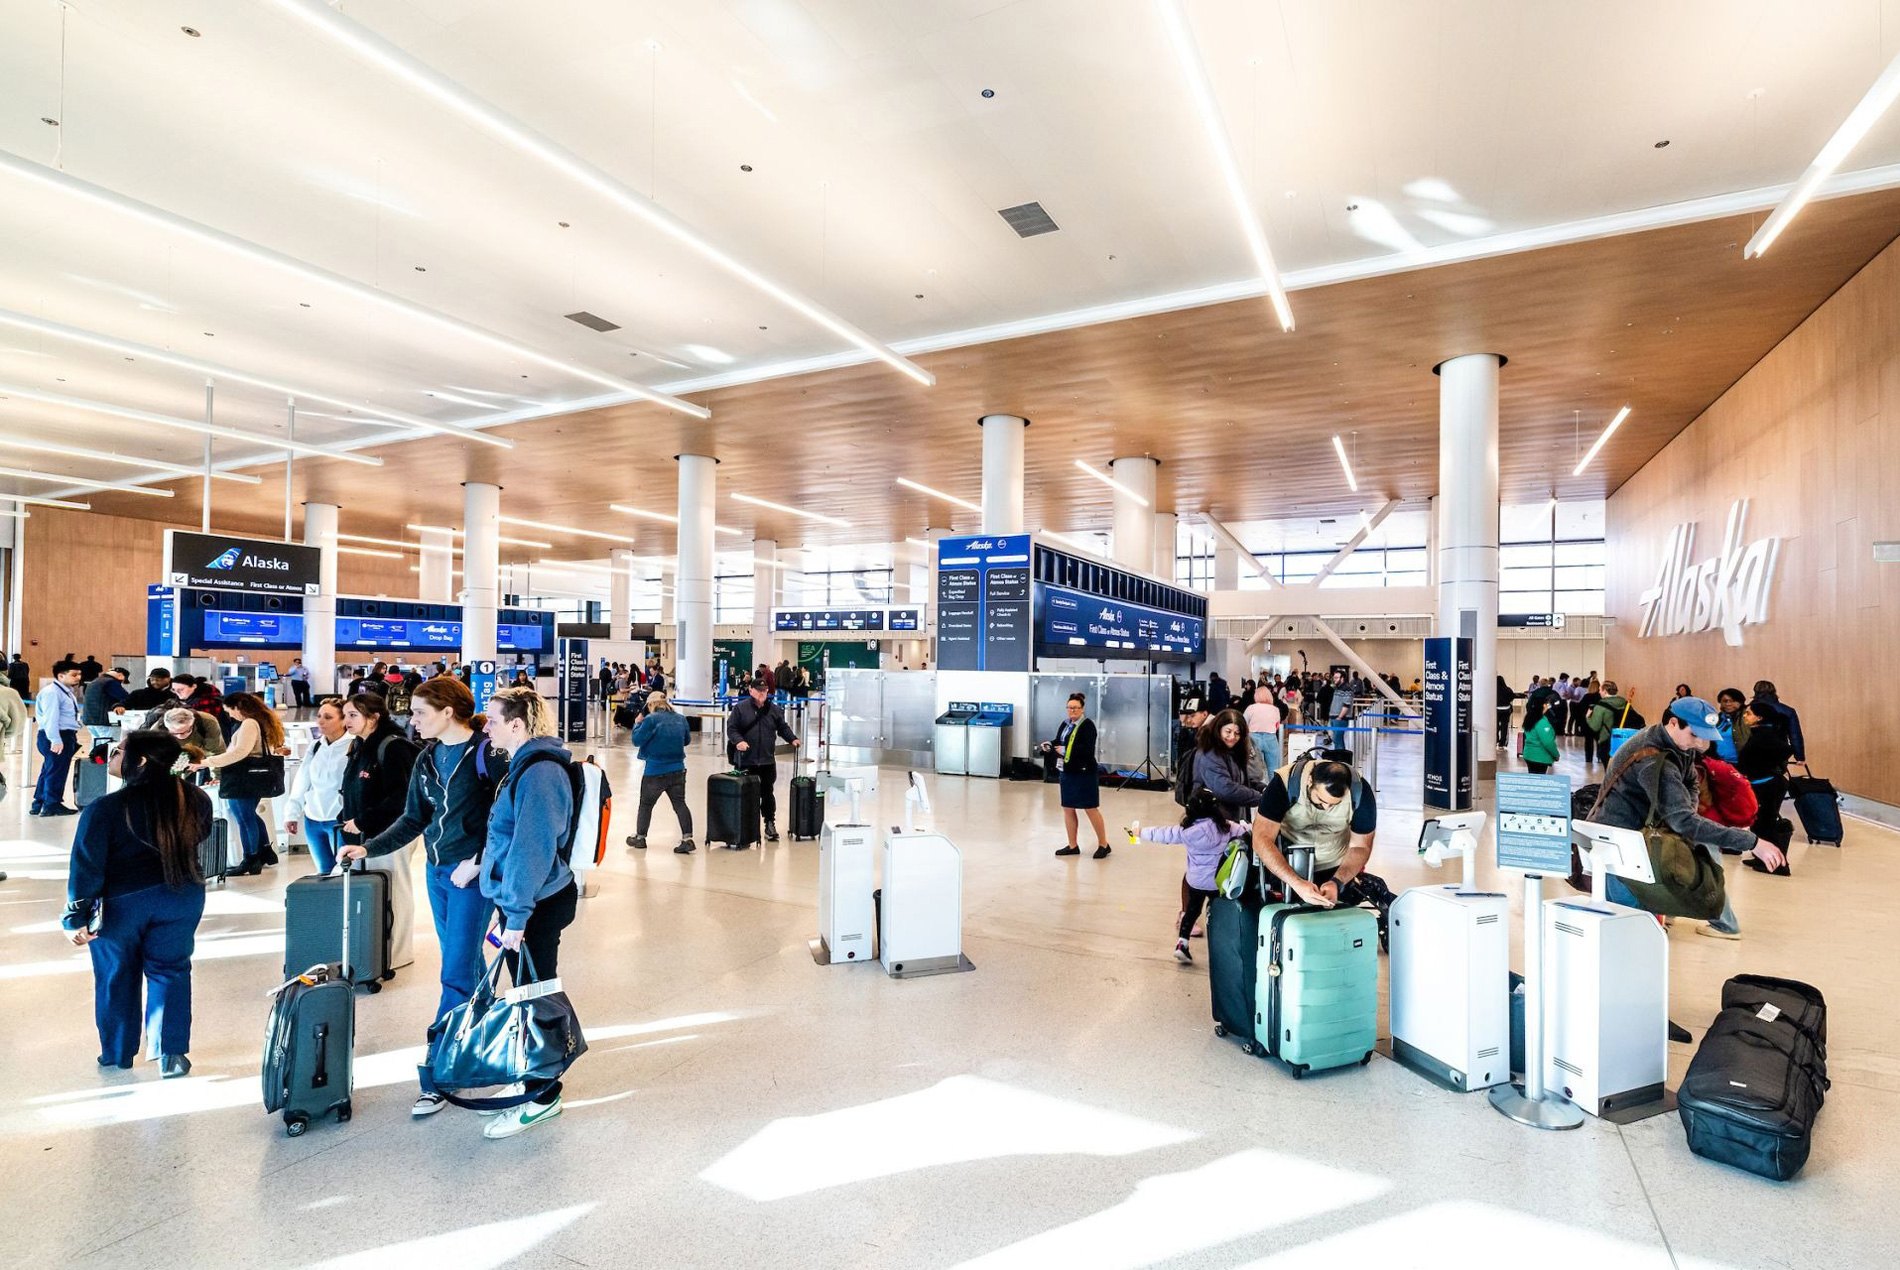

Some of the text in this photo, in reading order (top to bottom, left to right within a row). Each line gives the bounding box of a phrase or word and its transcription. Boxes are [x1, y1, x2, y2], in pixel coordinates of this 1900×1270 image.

[966, 540, 992, 550] Alaska
[242, 556, 289, 570] Alaska
[1638, 498, 1780, 646] Alaska
[191, 577, 212, 585] Special
[1099, 607, 1115, 622] Alaska
[422, 625, 448, 634] Alaska
[1089, 624, 1097, 633] First
[1098, 625, 1107, 634] Class
[1110, 627, 1120, 636] Atmos
[1121, 628, 1130, 637] Status
[484, 664, 489, 672] 1
[1426, 661, 1437, 669] First
[1458, 661, 1469, 670] First
[1426, 671, 1448, 680] Class &
[481, 682, 493, 699] Tag
[1426, 682, 1445, 691] Atmos
[1426, 692, 1443, 701] Status
